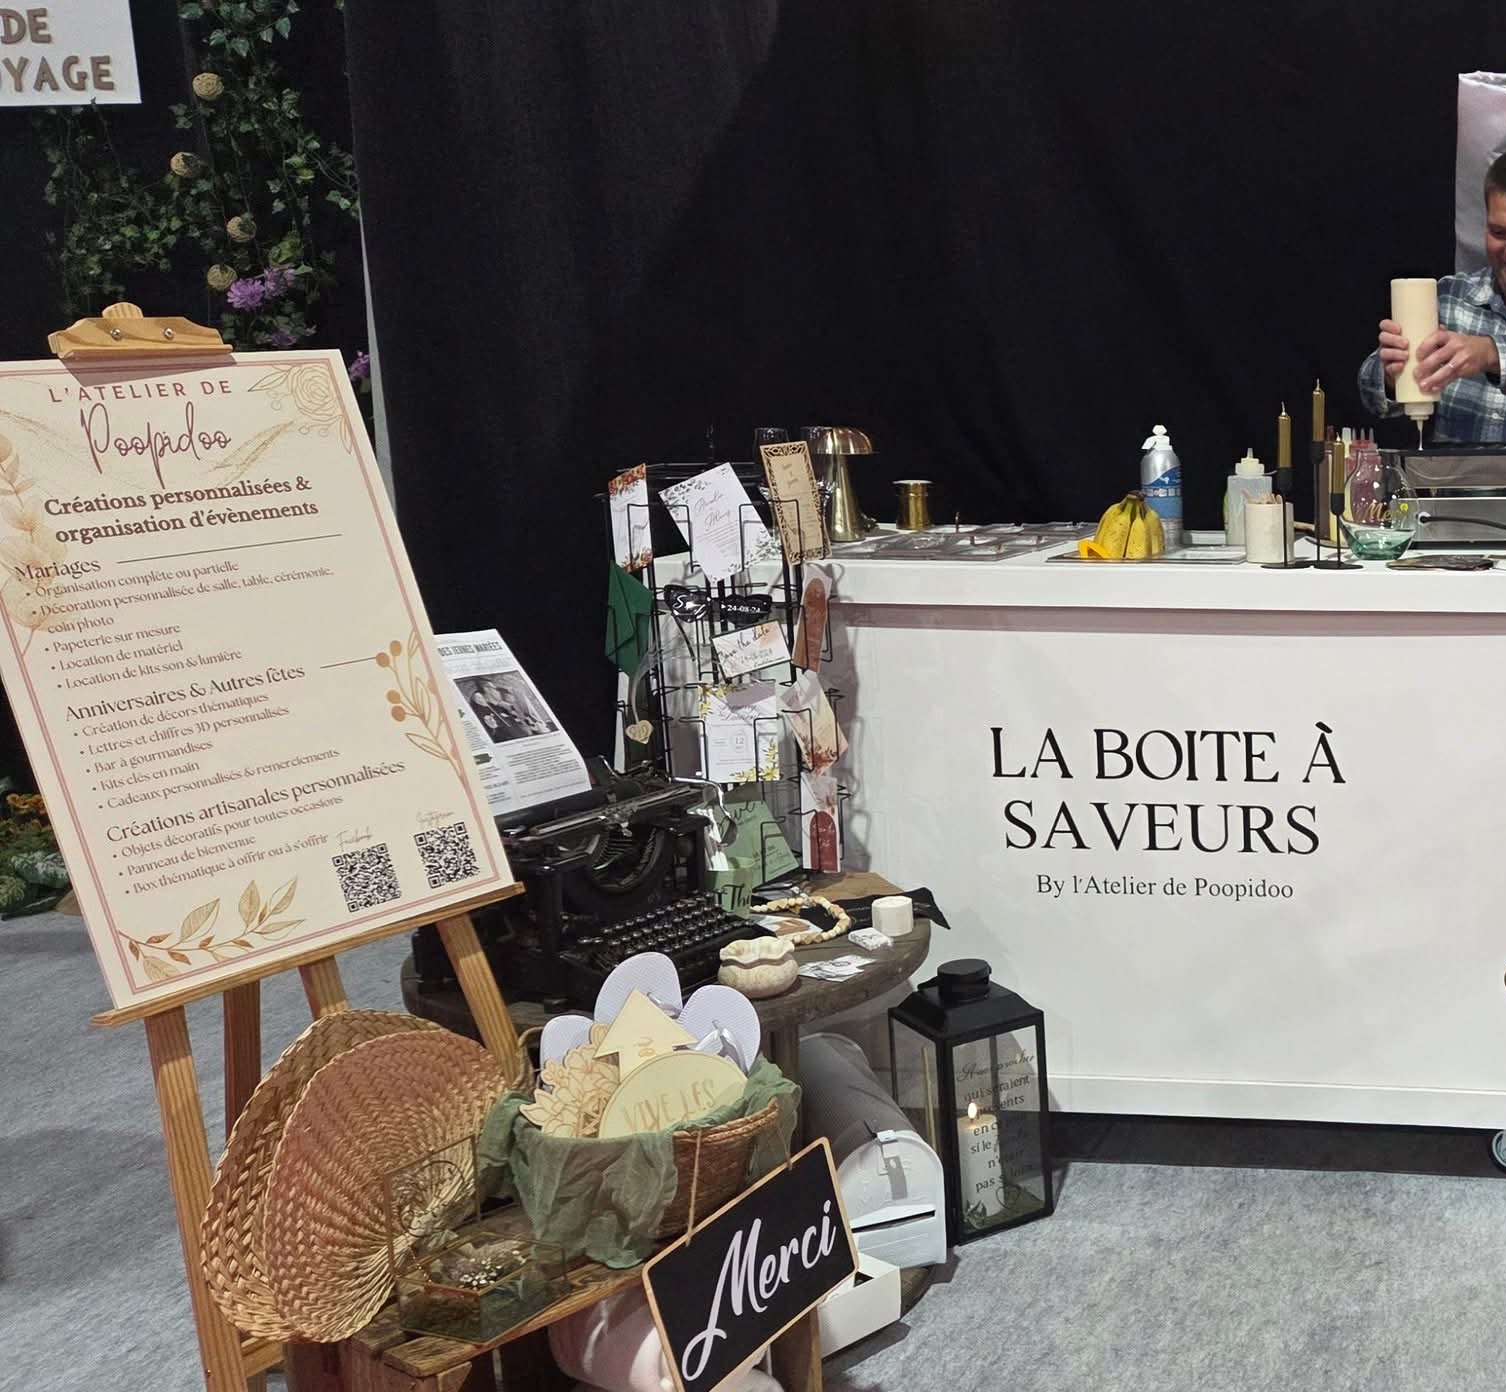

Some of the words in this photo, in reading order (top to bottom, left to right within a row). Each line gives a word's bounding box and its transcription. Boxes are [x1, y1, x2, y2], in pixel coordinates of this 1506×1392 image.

[0, 8, 51, 44] DE
[0, 55, 115, 92] YAGE
[48, 383, 187, 403] L'ATELIER
[200, 380, 232, 395] DE
[81, 401, 231, 490] Poopidoo
[44, 494, 147, 517] Créations
[150, 479, 292, 509] personnalisées
[295, 476, 312, 491] &
[55, 516, 186, 545] organisation
[190, 501, 319, 529] d'évènements
[15, 560, 102, 580] Mariages
[35, 577, 116, 598] Organisation
[118, 570, 174, 588] complète
[175, 568, 191, 580] ou
[193, 561, 239, 579] partielle
[40, 598, 112, 617] Décoration
[113, 586, 195, 609] personnalisée
[197, 583, 210, 594] de
[212, 579, 241, 592] salle,
[242, 574, 274, 588] table,
[47, 621, 76, 634] coin
[77, 615, 115, 633] photo
[53, 633, 113, 653] Papeterie
[115, 633, 134, 642] sur
[136, 624, 181, 639] mesure
[60, 653, 115, 671] Location
[118, 650, 132, 661] de
[133, 640, 183, 659] matériel
[66, 671, 121, 689] Location
[123, 667, 137, 679] de
[140, 663, 161, 676] kits
[162, 660, 185, 672] son
[186, 657, 198, 667] &
[198, 650, 242, 665] lumière
[66, 689, 187, 721] Anniversaires
[190, 682, 207, 697] &
[210, 674, 264, 694] Autres
[266, 667, 305, 684] fêtes
[82, 718, 138, 737] Création
[139, 714, 154, 725] de
[157, 705, 198, 722] décors
[199, 694, 269, 715] thématiques
[88, 738, 133, 755] Lettres
[135, 734, 147, 745] et
[149, 726, 194, 743] chiffres
[196, 721, 210, 734] 3D
[213, 706, 290, 732] personnalisés
[94, 760, 117, 774] Bar
[120, 758, 128, 768] à
[129, 741, 214, 768] gourmandises
[991, 727, 1074, 779] LA
[1093, 728, 1280, 784] BOITE
[1302, 721, 1346, 784] À
[100, 778, 125, 791] Kits
[152, 769, 168, 780] en
[170, 762, 200, 777] main
[107, 789, 162, 809] Cadeaux
[163, 770, 242, 799] personnalisés
[244, 768, 255, 777] &
[106, 810, 195, 842] Créations
[199, 787, 290, 820] artisanales
[291, 761, 405, 800] personnalisées
[121, 840, 162, 858] Objets
[164, 823, 222, 847] décoratifs
[224, 818, 251, 836] pour
[254, 810, 289, 825] toutes
[290, 794, 344, 815] occasions
[1003, 800, 1321, 855] SAVEURS
[127, 855, 180, 876] Panneau
[180, 850, 196, 862] de
[198, 835, 256, 857] bienvenue
[133, 881, 157, 894] Box
[158, 862, 226, 887] thématique
[228, 857, 236, 868] à
[237, 850, 265, 866] offrir
[268, 848, 284, 857] ou
[285, 845, 292, 855] à
[1036, 874, 1065, 898] By
[1073, 875, 1156, 896] l'Atelier
[1163, 878, 1187, 896] de
[1194, 877, 1294, 902] Poopidoo
[680, 1078, 715, 1124] LES
[681, 1199, 837, 1382] Merci
